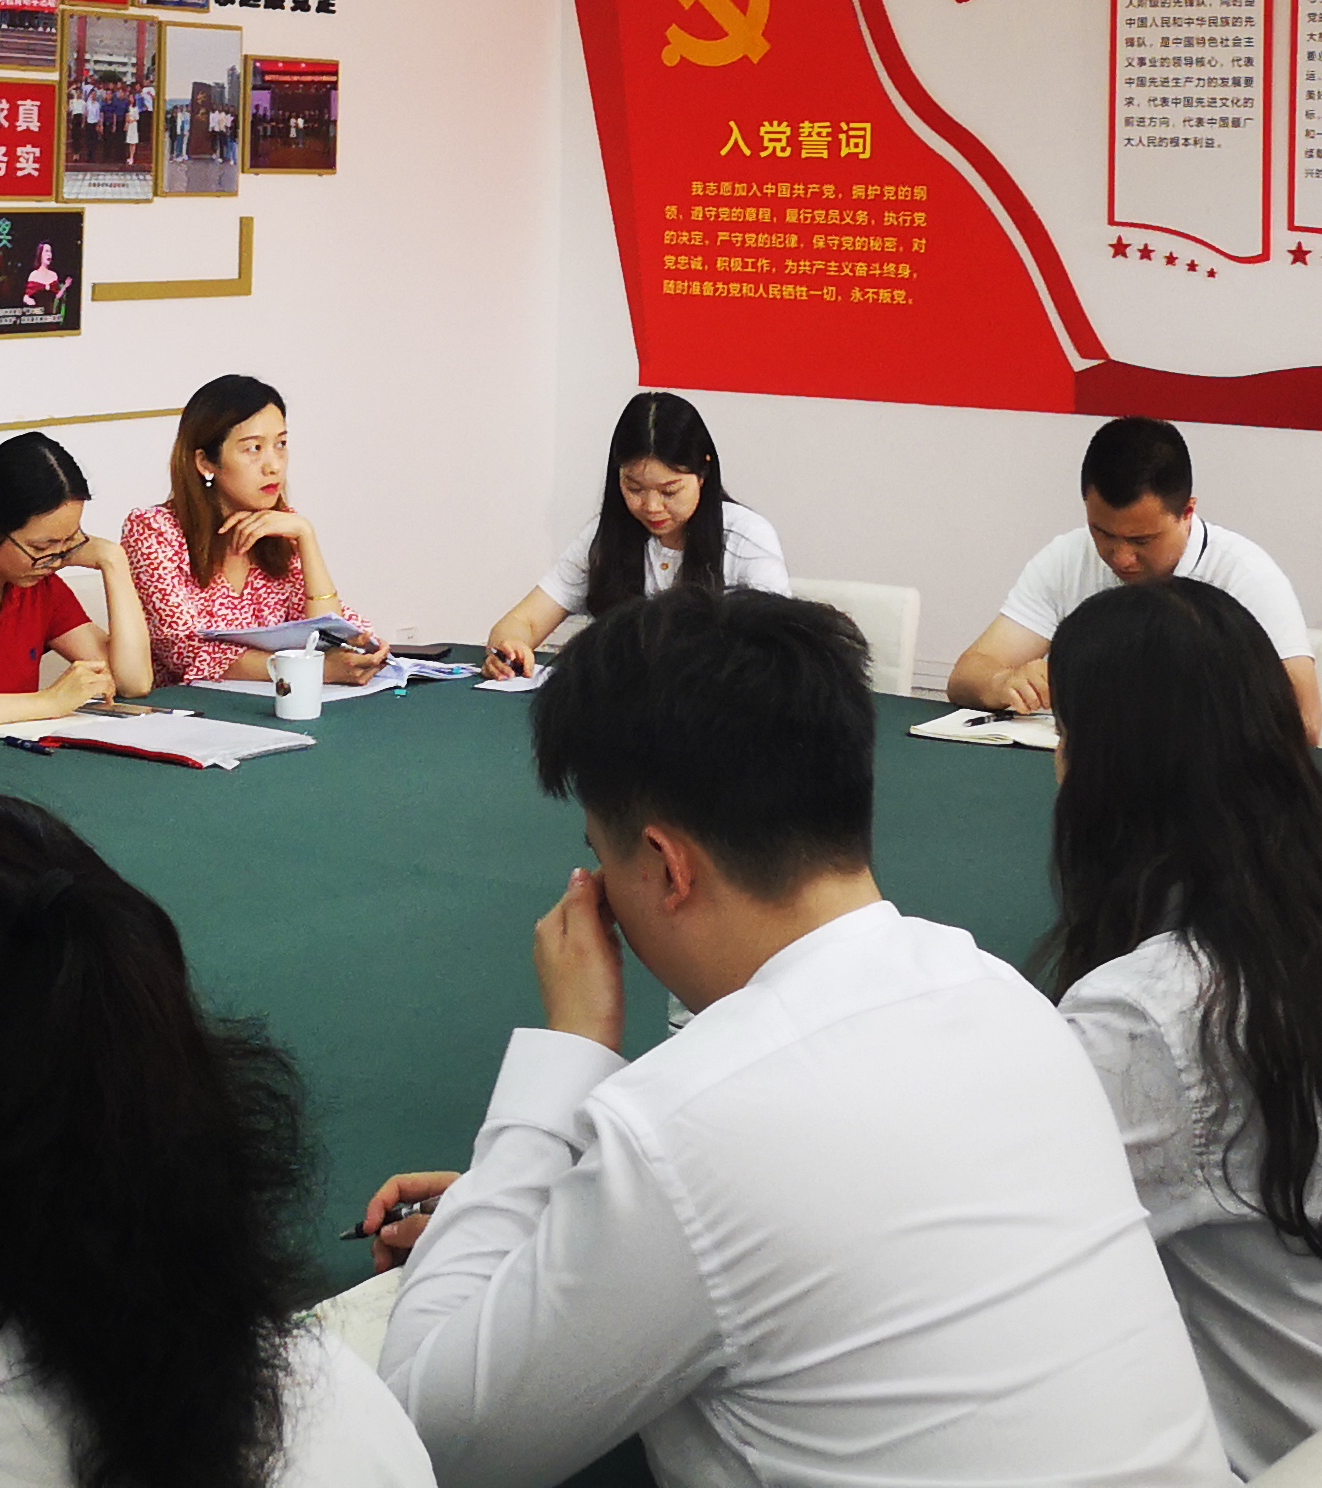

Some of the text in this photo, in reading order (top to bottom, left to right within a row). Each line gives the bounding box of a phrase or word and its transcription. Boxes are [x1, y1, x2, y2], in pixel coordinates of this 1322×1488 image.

[1125, 16, 1256, 28] 中国人民和中华民族的先
[720, 120, 872, 159] 入党誓词
